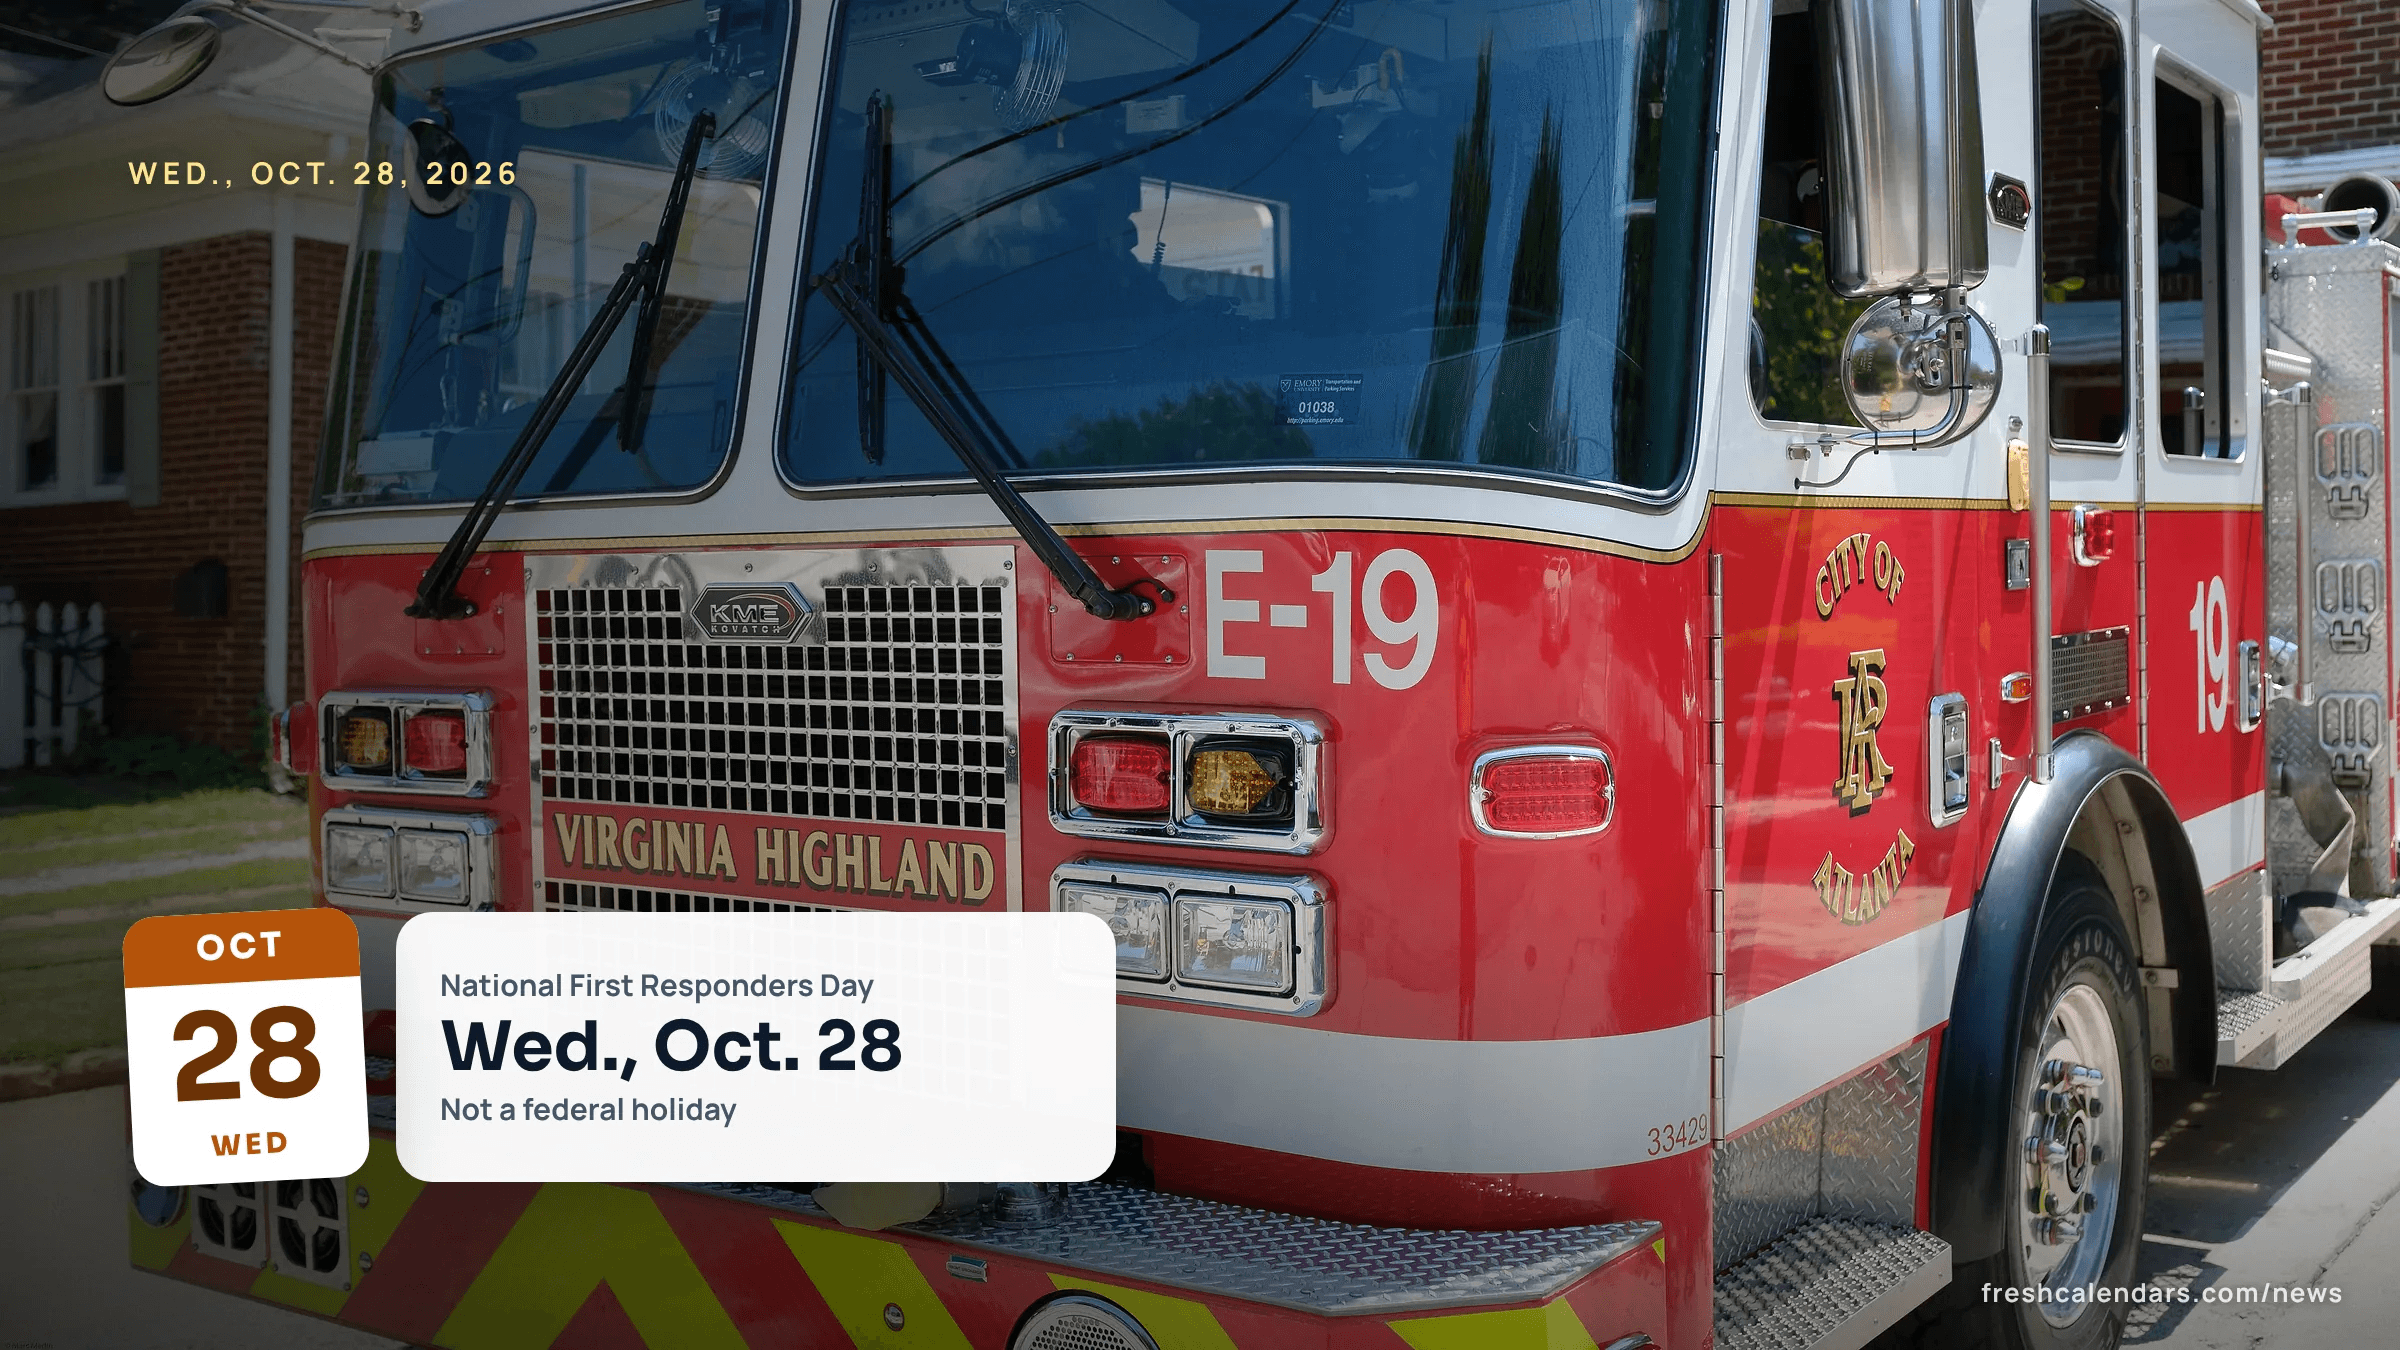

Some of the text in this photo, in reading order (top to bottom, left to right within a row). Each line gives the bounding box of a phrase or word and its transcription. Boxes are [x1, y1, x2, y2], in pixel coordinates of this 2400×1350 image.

[1294, 379, 1322, 387] EMORY
[1298, 401, 1335, 414] 01038
[1815, 532, 1906, 622] CITY OF
[710, 604, 780, 623] KME
[711, 625, 781, 634] KOVATCH
[1205, 548, 1440, 691] E-19
[2189, 574, 2230, 735] 19
[552, 812, 996, 907] VIRGINIA HIGHLAND
[1811, 828, 1916, 926] ATLANTA
[1647, 1113, 1708, 1156] 33429
